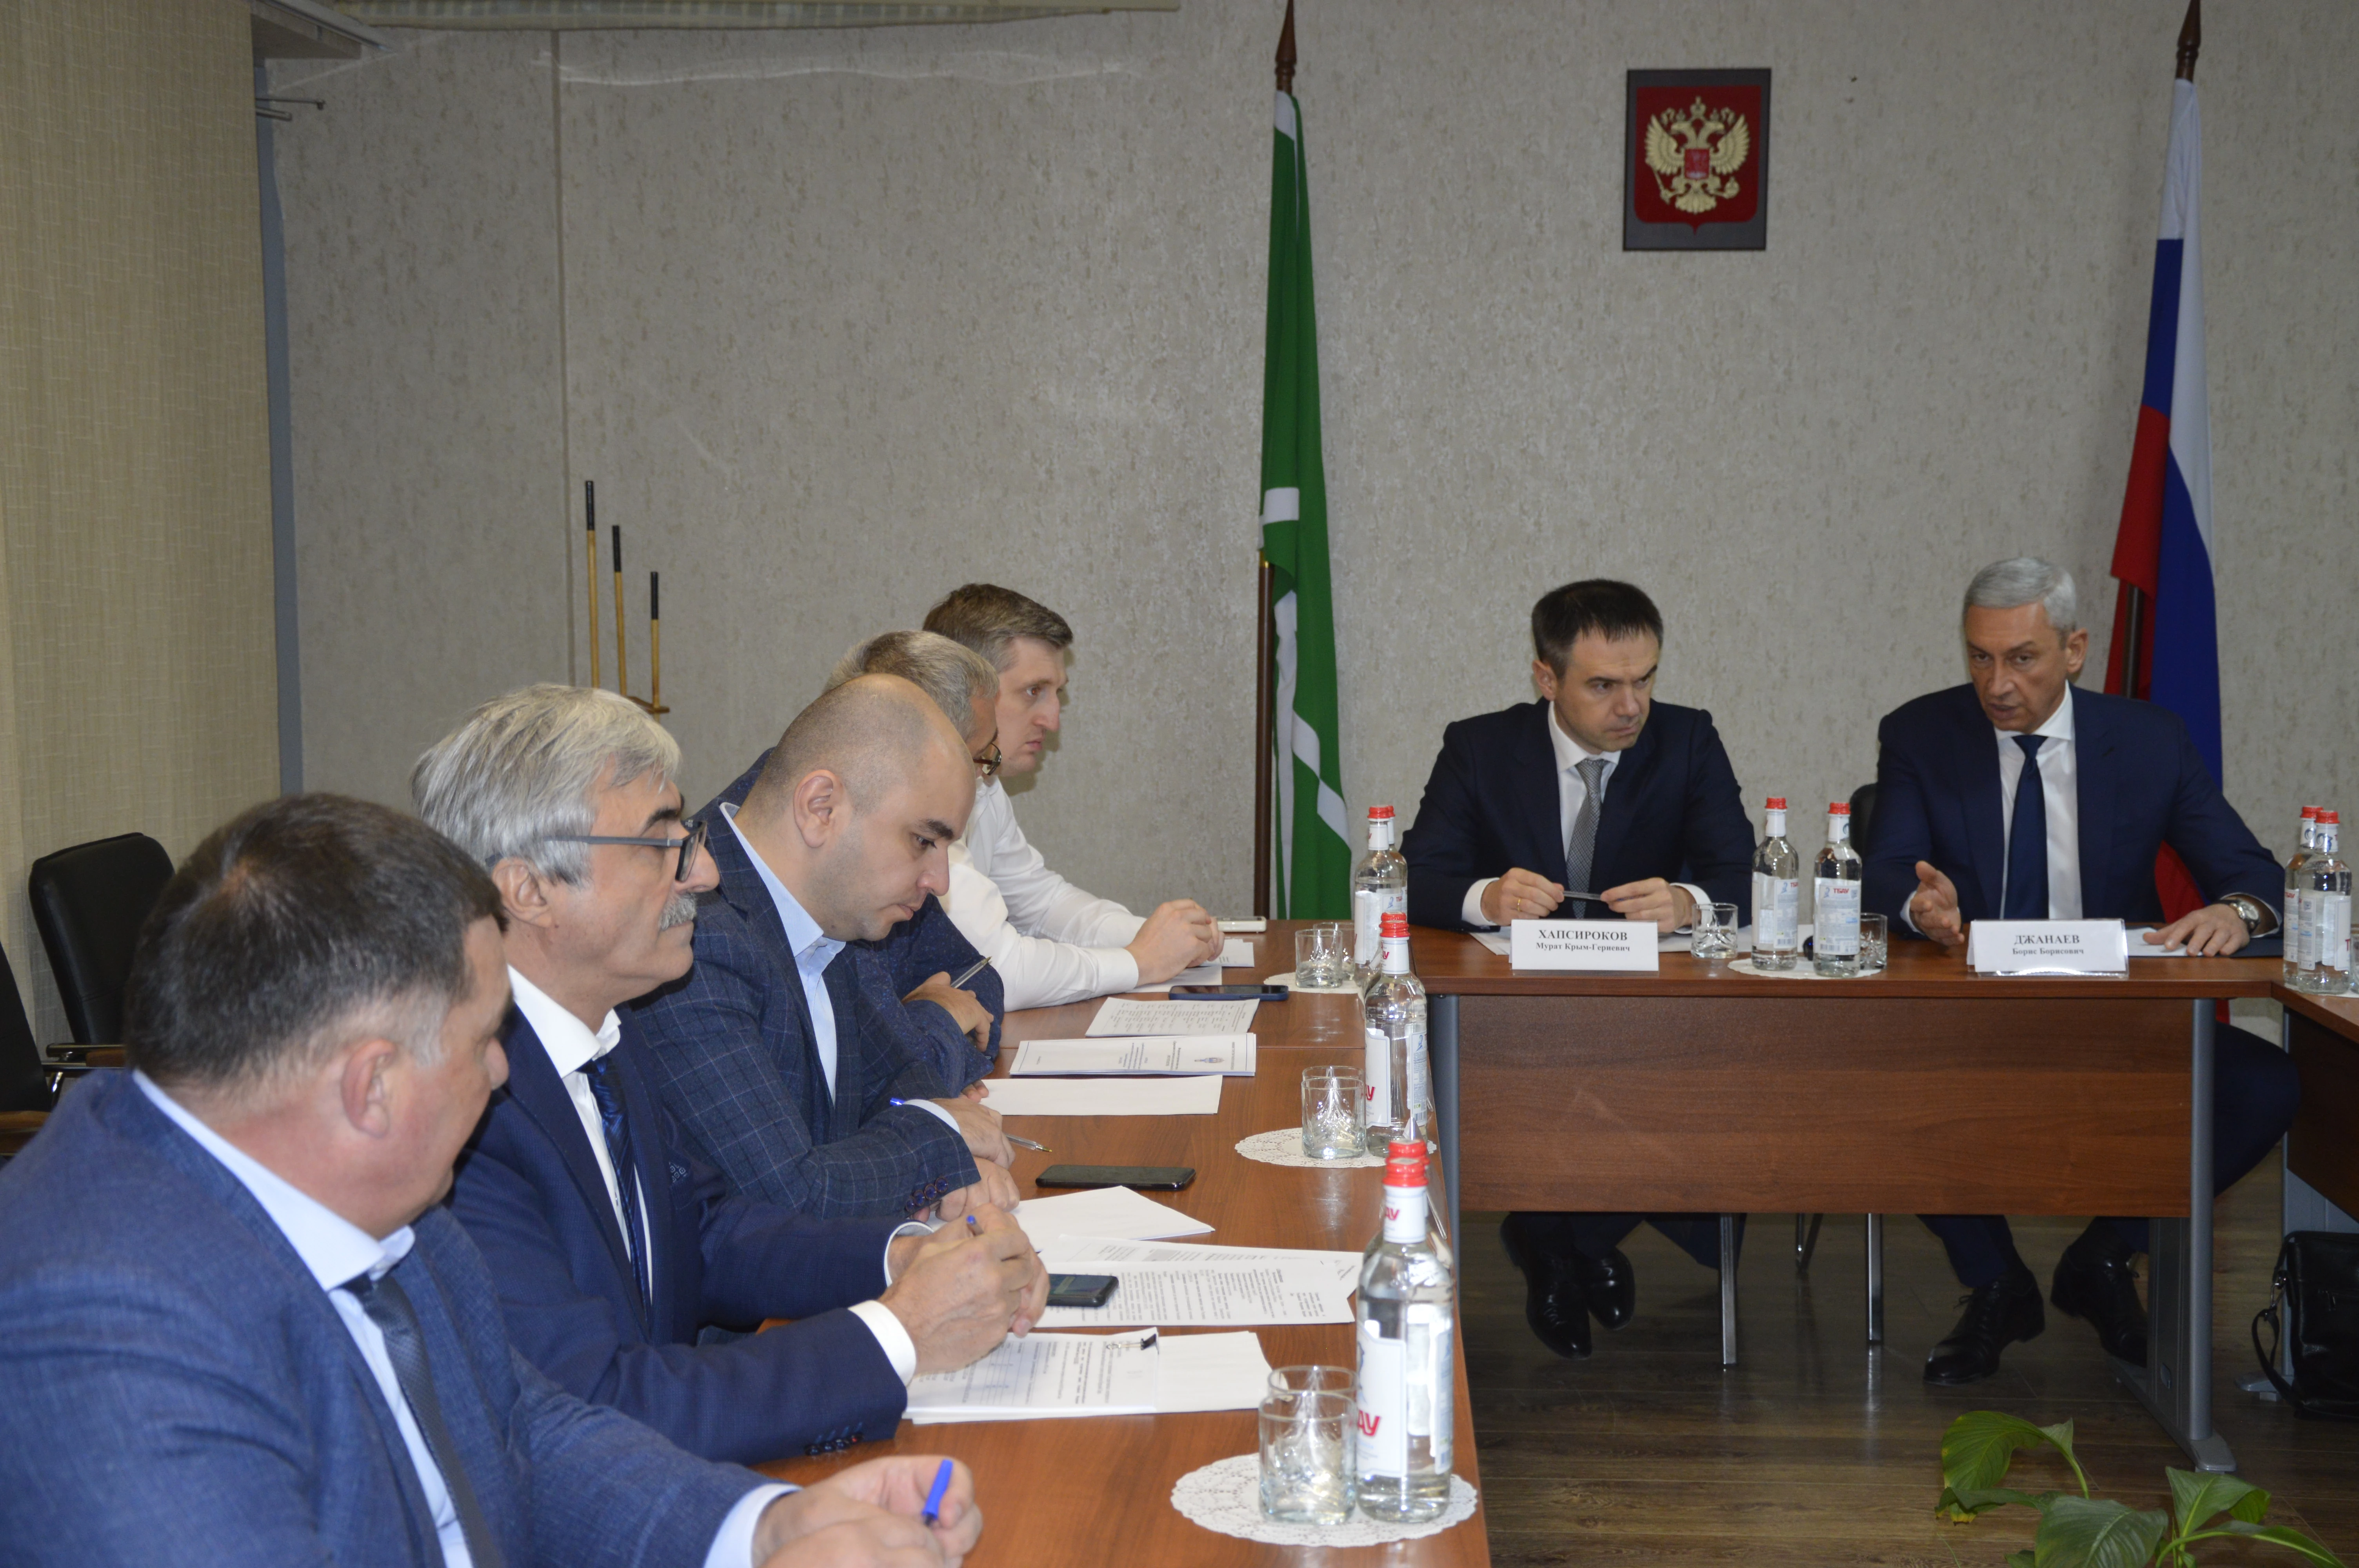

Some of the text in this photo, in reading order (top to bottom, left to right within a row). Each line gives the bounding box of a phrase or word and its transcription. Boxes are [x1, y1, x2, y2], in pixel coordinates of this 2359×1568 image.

[1538, 929, 1628, 941] ХАПСИРОКОВ
[2014, 935, 2080, 945] ДЖАНАЕВ
[1536, 942, 1630, 952] Мурат Крым-Гериевич
